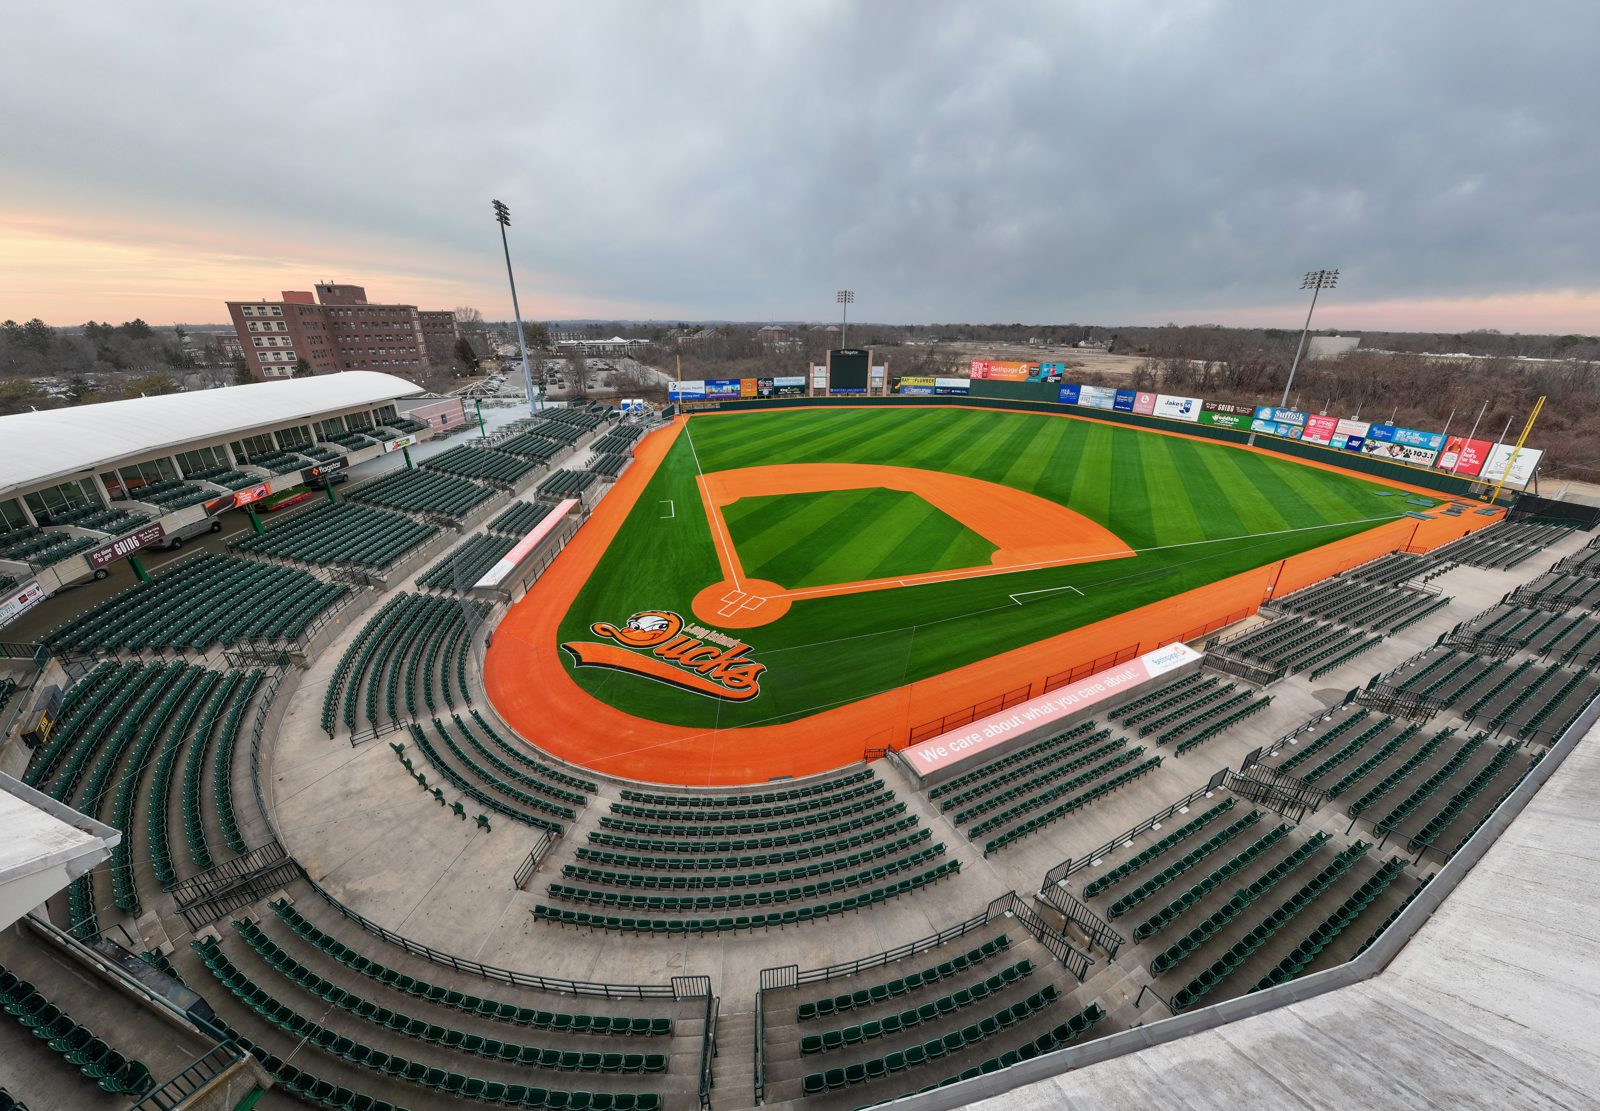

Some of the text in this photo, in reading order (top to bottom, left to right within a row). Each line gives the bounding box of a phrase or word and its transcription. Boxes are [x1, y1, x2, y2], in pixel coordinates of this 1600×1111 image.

[990, 365, 1019, 374] Bethpage
[1165, 400, 1184, 408] Jakes
[1413, 450, 1434, 460] 103.1
[318, 461, 341, 474] flagstar
[114, 535, 140, 557] GOING
[683, 622, 741, 649] Long Island
[590, 610, 768, 692] Ducks
[917, 744, 949, 764] We
[948, 731, 983, 753] care
[981, 714, 1026, 740] about
[1022, 700, 1059, 723] what
[1055, 693, 1082, 714] you
[1079, 682, 1106, 702] care
